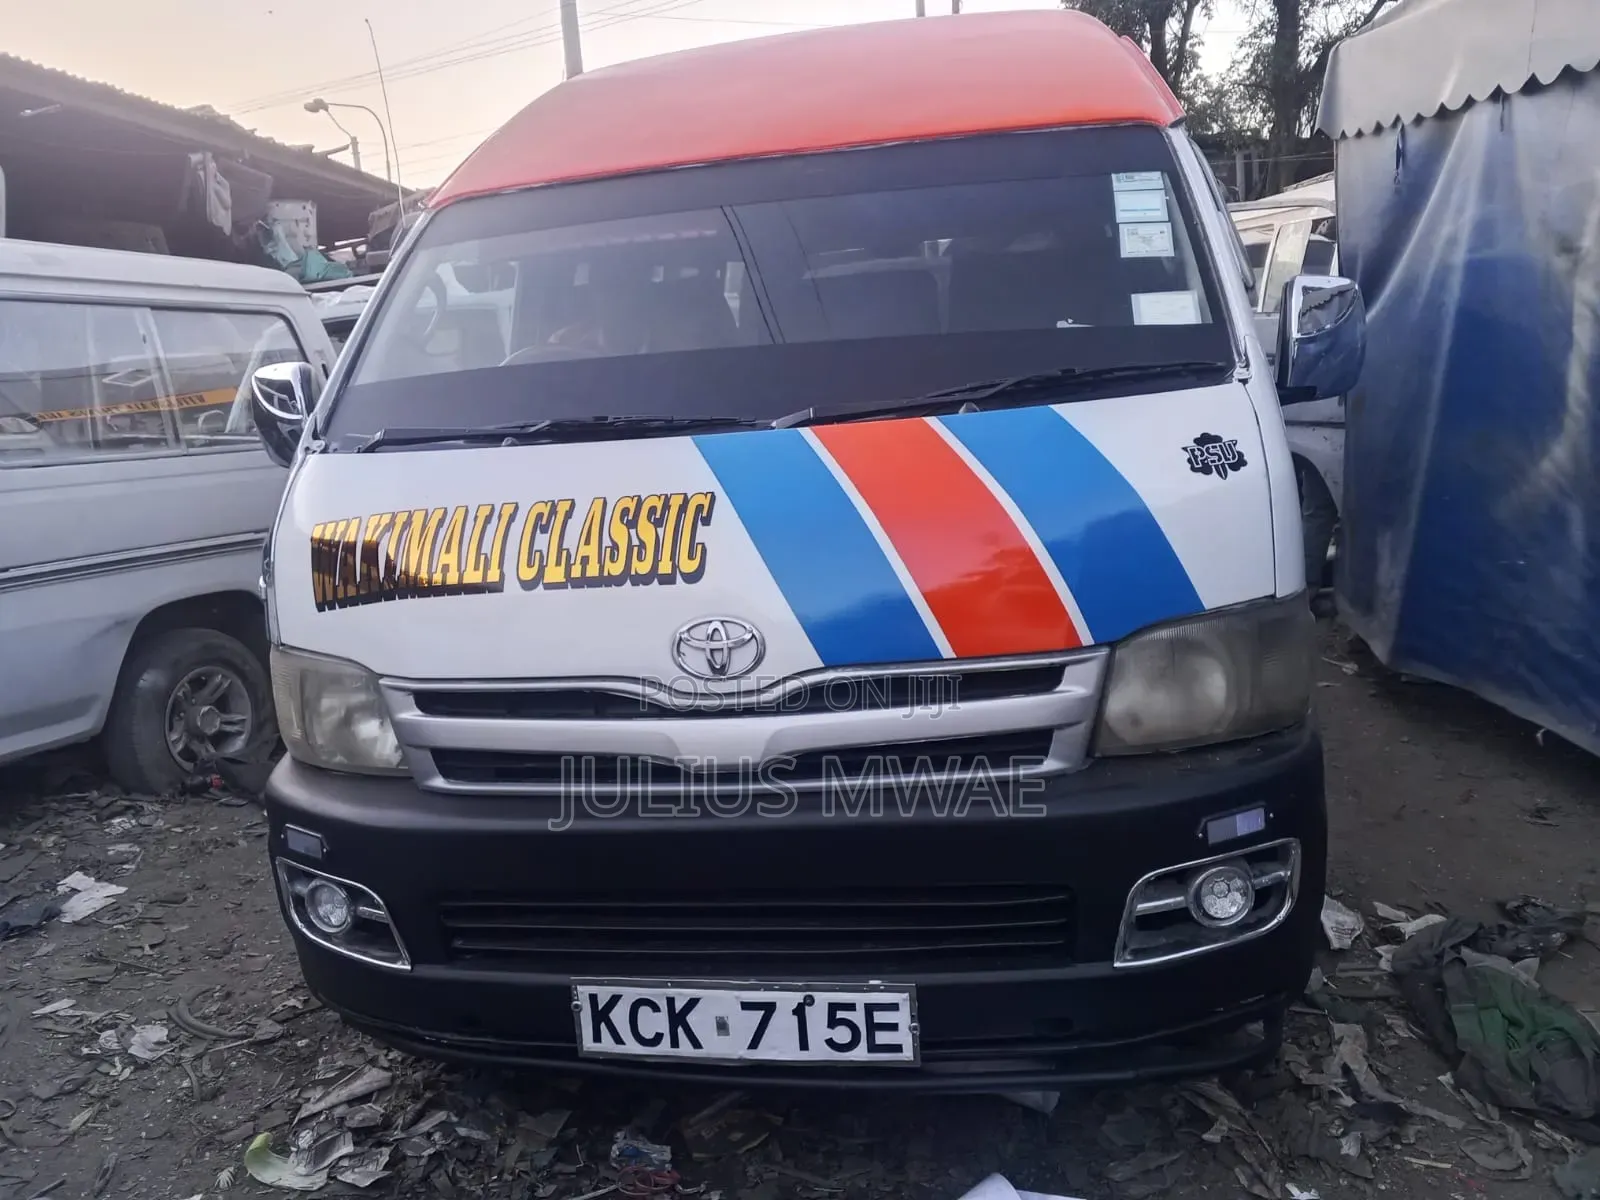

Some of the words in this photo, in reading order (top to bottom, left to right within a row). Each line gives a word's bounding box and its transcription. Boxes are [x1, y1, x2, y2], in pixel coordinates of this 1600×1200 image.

[1183, 440, 1239, 468] PSU
[310, 502, 519, 612] WAKIMALI
[516, 492, 716, 591] CLASSIC
[588, 993, 704, 1050] KCK
[740, 1000, 903, 1054] 715E
